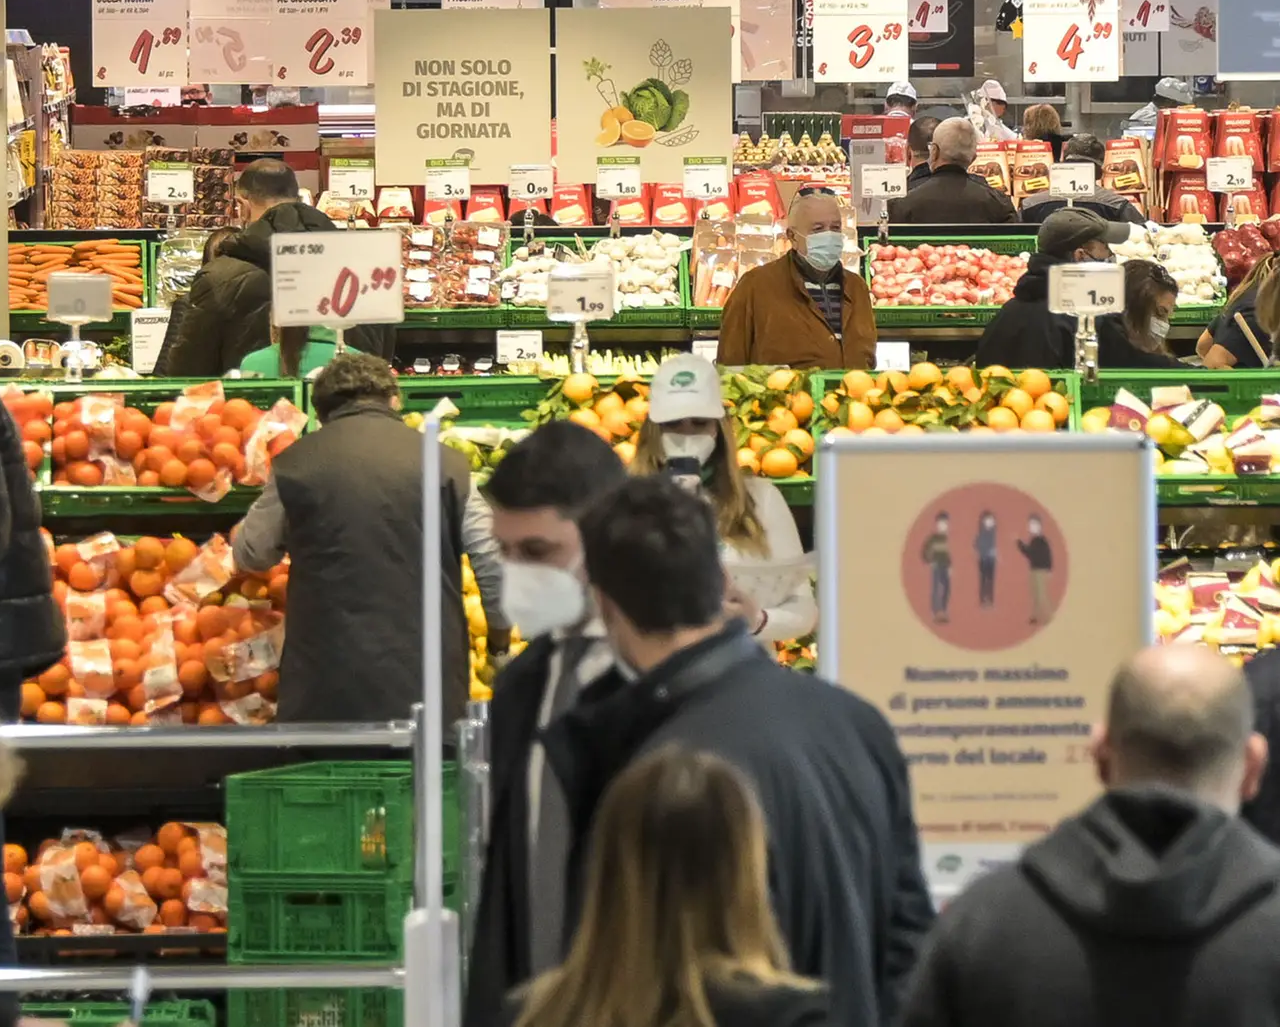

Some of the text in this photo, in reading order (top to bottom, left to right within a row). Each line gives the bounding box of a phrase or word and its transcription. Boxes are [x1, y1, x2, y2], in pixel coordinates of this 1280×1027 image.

[414, 59, 512, 76] NON SOLO
[402, 80, 525, 100] DI STAGIONE,
[436, 101, 490, 117] MA DI
[416, 122, 512, 139] GIORNATA
[881, 181, 901, 193] 1,89
[1069, 180, 1089, 192] 1,49
[1226, 174, 1246, 186] 2,19
[168, 187, 188, 199] 2,49
[349, 184, 368, 196] 1,79
[444, 184, 465, 196] 3,49
[527, 183, 548, 195] 0,99
[616, 182, 636, 194] 1,80
[703, 183, 723, 194] 1,49
[576, 297, 605, 313] 1,99
[1087, 290, 1115, 306] 1,99
[516, 348, 537, 360] 2,99
[905, 664, 1068, 683] Numero massimo
[889, 692, 1086, 714] di persone ammesse
[894, 722, 1091, 742] ontemporaneamente
[954, 747, 984, 764] del
[989, 747, 1046, 764] locale
